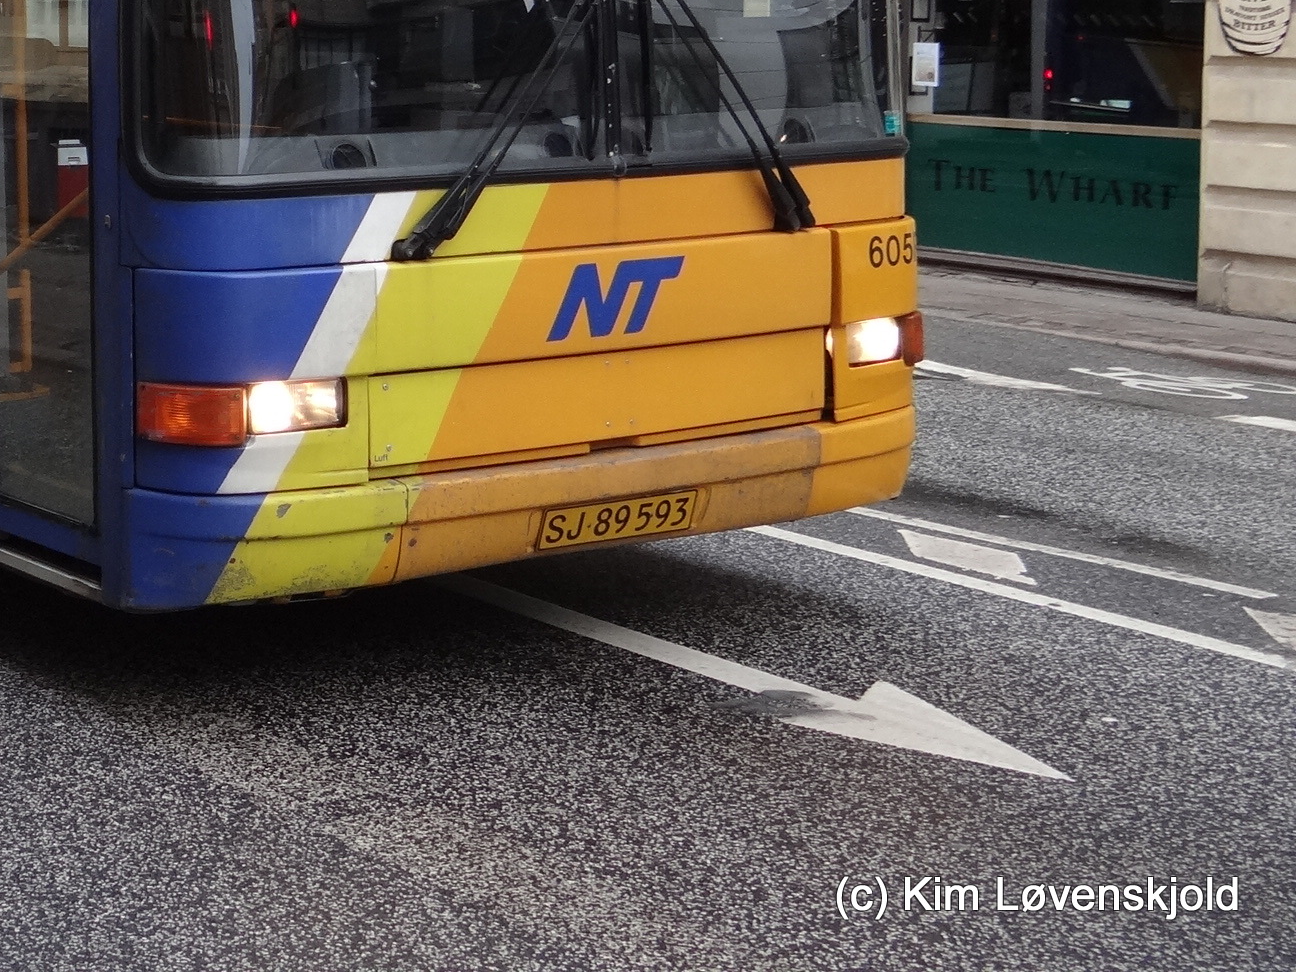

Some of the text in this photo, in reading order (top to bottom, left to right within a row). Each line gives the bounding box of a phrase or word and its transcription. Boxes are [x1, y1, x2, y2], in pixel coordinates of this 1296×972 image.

[1233, 19, 1275, 31] BITTER
[928, 159, 1178, 210] THE WHARF
[869, 232, 913, 269] 605
[546, 255, 685, 342] NT
